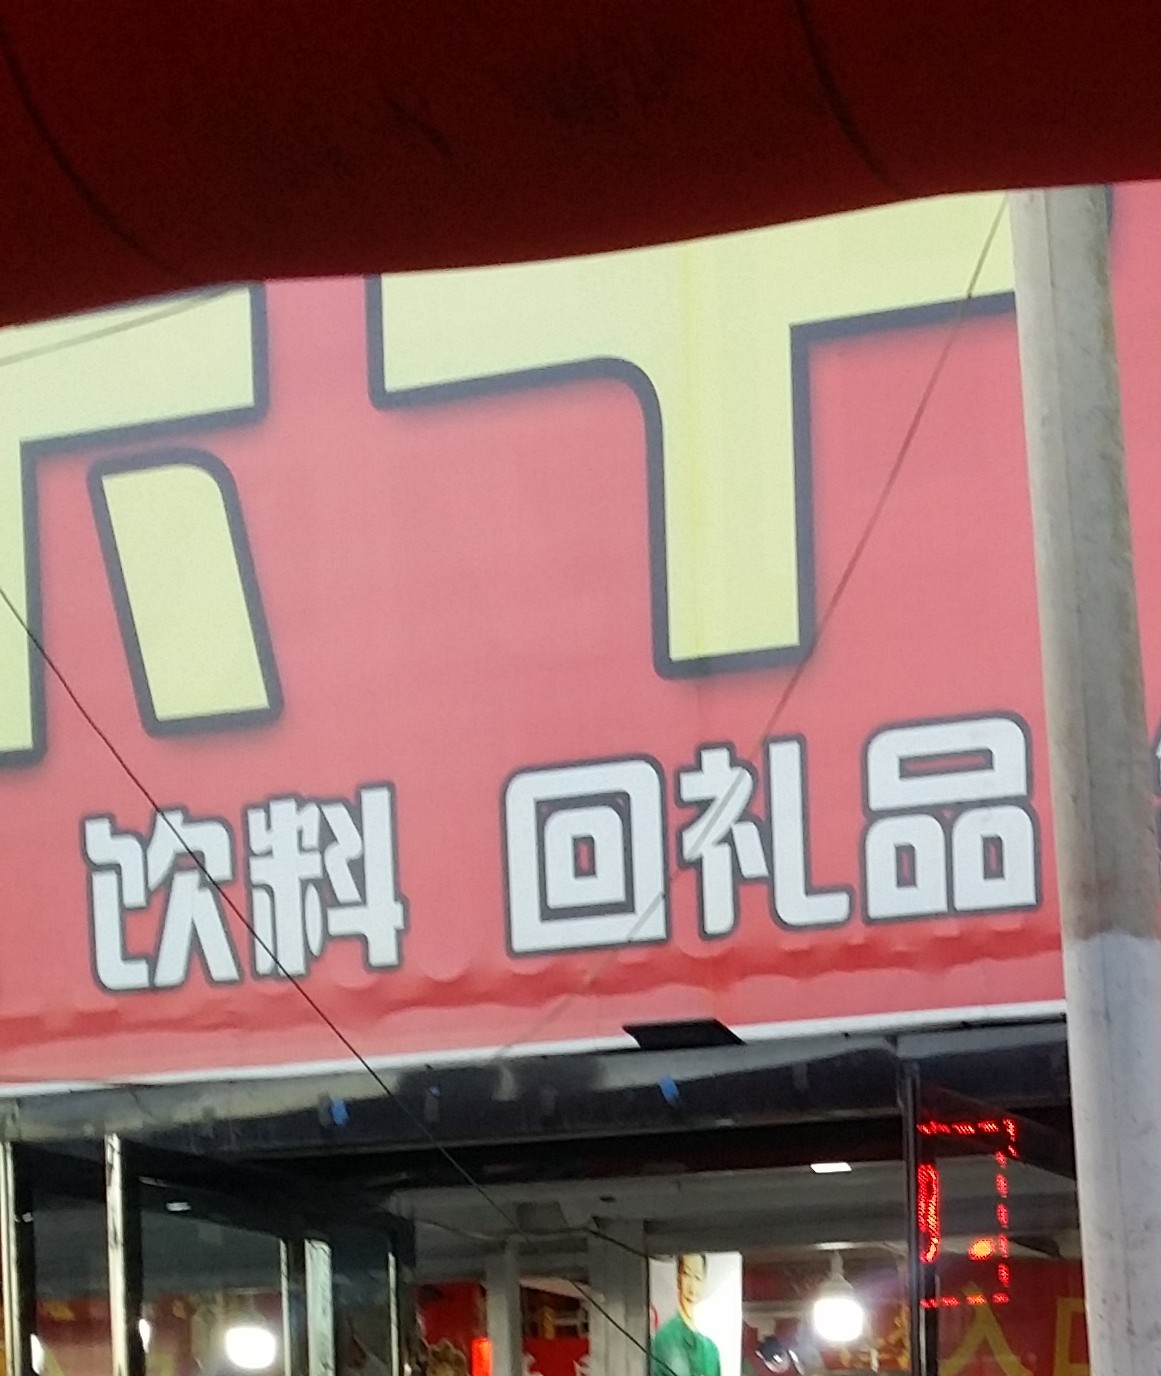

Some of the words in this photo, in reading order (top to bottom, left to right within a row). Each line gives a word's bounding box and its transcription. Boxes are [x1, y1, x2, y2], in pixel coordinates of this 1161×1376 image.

[85, 780, 410, 992] 饮料
[505, 713, 1038, 957] 回礼品
